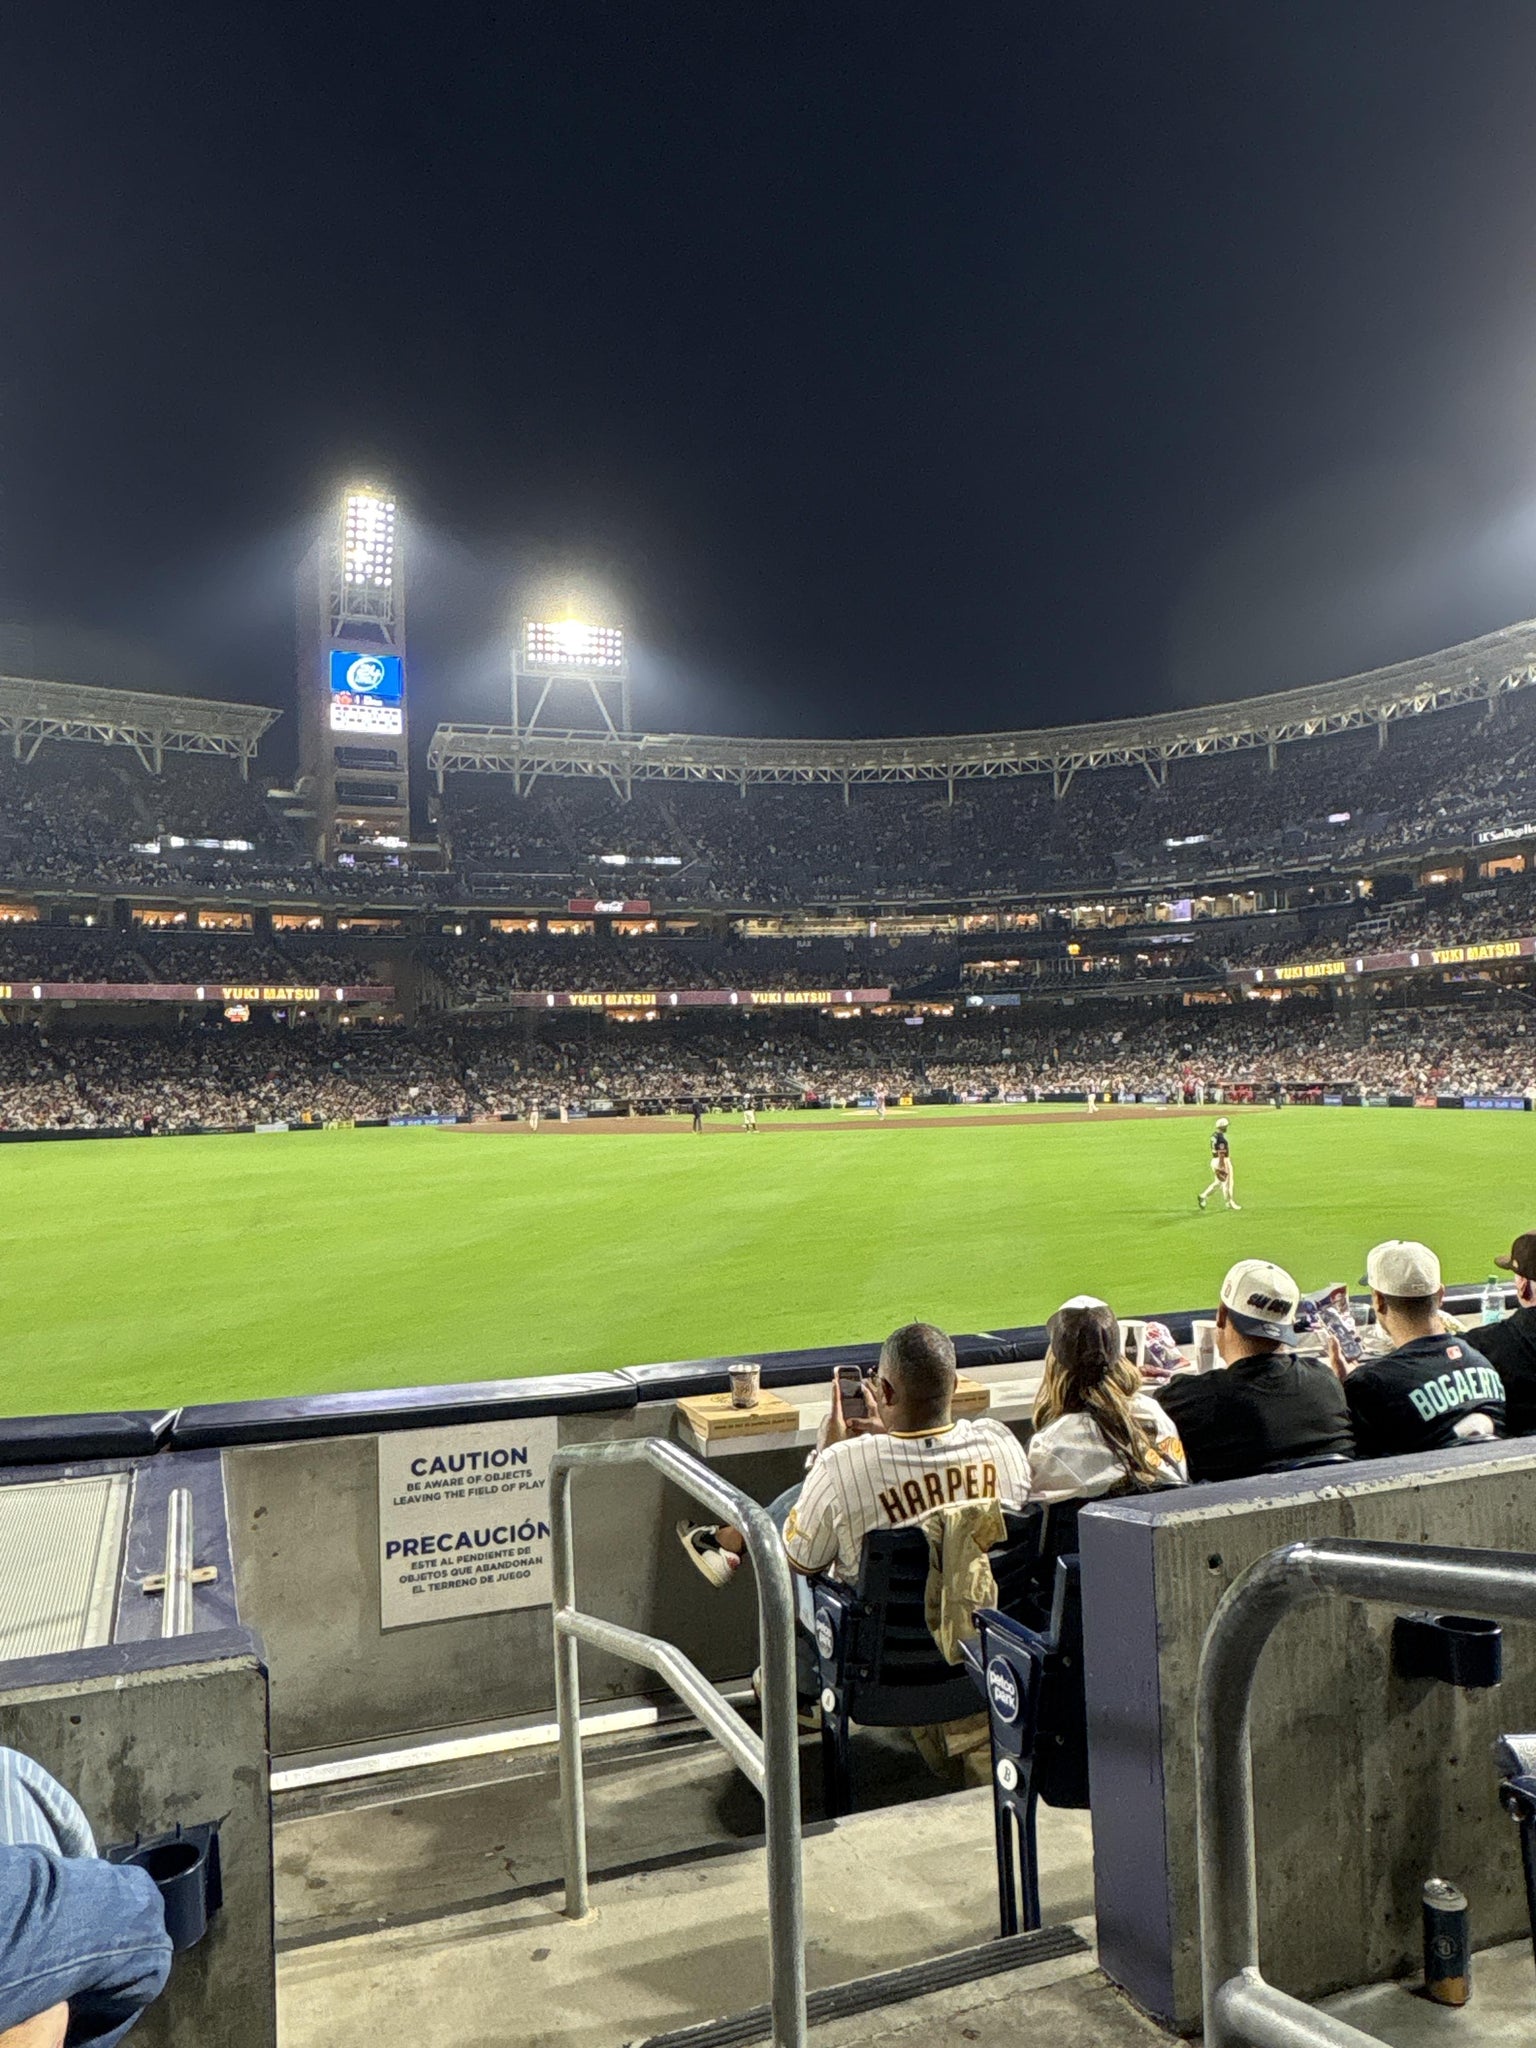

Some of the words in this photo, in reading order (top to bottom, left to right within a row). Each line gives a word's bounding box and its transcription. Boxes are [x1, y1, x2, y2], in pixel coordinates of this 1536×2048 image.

[1431, 949, 1464, 964] YUKI
[1467, 942, 1520, 961] MATSUI
[1275, 966, 1303, 979] YUKI
[1304, 962, 1345, 977] MATSUI
[222, 988, 259, 999] YUKI
[263, 988, 320, 1000] MATSUI
[569, 994, 602, 1005] YUKI
[605, 994, 656, 1005] MATSUI
[751, 993, 781, 1004] YUKI
[785, 992, 831, 1003] MATSUI
[1408, 1367, 1506, 1422] BOGAERTS
[411, 1446, 527, 1477] CAUTION
[393, 1492, 441, 1506] LEAVING
[444, 1489, 465, 1499] THE
[468, 1486, 498, 1496] FIELD
[501, 1484, 516, 1492] OF
[519, 1479, 546, 1491] PLAY
[407, 1482, 421, 1492] BE
[424, 1477, 464, 1490] AWARE
[466, 1475, 482, 1485] OF
[485, 1469, 532, 1482] OBJECTS
[878, 1463, 996, 1523] HARPER
[386, 1518, 551, 1560] PRECAUCIÓN
[399, 1571, 448, 1583] OBJETOS
[451, 1566, 472, 1576] QUE
[475, 1556, 543, 1573] ABANDONAN
[411, 1559, 437, 1570] ESTE
[440, 1557, 453, 1566] AL
[456, 1548, 515, 1564] PENDIENTE
[517, 1546, 531, 1555] DE
[412, 1584, 426, 1594] EL
[428, 1578, 478, 1592] TERRENO
[480, 1574, 494, 1584] DE
[496, 1569, 531, 1582] JUEGO
[990, 1669, 1015, 1696] petco
[994, 1685, 1016, 1710] park
[1004, 1766, 1011, 1782] B
